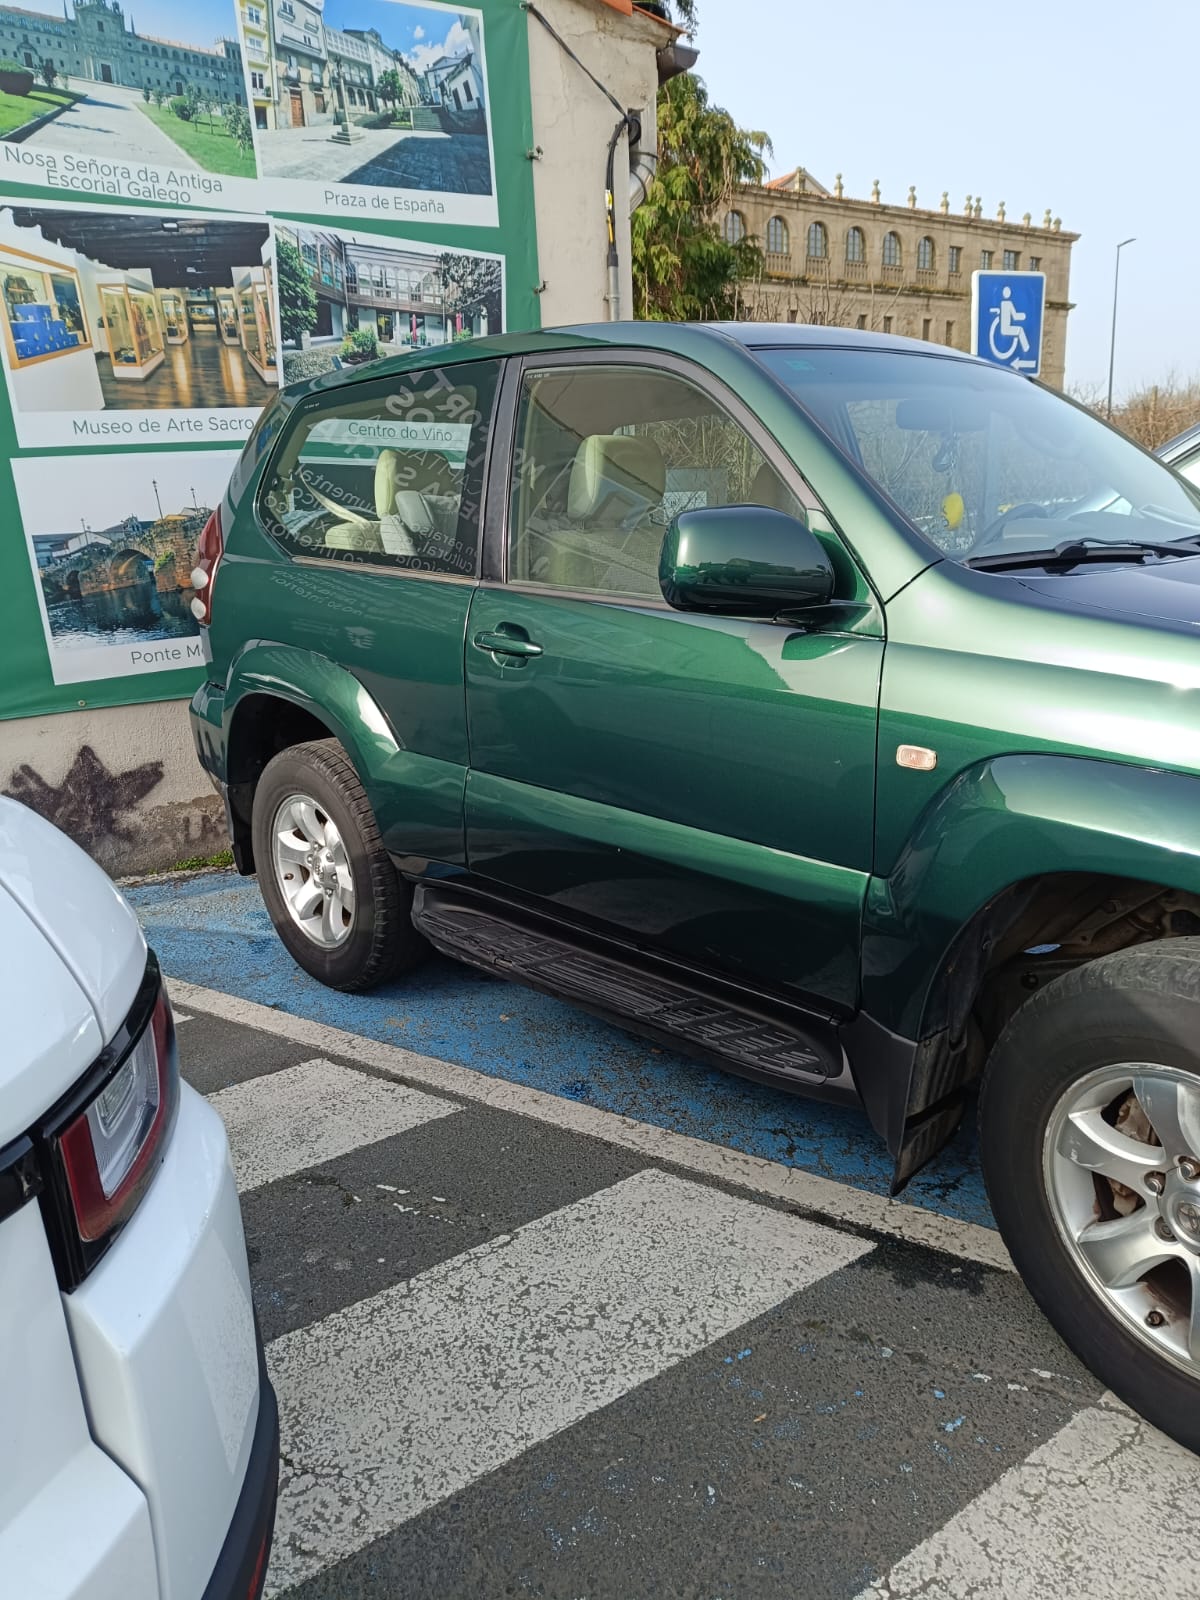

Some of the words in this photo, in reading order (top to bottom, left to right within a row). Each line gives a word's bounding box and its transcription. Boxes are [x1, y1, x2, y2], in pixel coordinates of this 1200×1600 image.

[4, 145, 57, 169] Nosa
[63, 155, 131, 179] Señora
[137, 167, 160, 184] da
[166, 171, 223, 193] Antiga
[46, 169, 121, 195] Escorial
[127, 182, 191, 204] Galego
[324, 190, 367, 208] Praza
[371, 195, 390, 209] de
[394, 196, 445, 214] España
[73, 419, 133, 435] Museo
[138, 418, 161, 433] de
[167, 417, 203, 432] Arte
[208, 416, 255, 431] Sacro
[348, 422, 396, 438] Centro
[400, 426, 418, 439] do
[422, 427, 453, 441] Viño
[131, 648, 181, 664] Ponte
[186, 644, 204, 658] M
